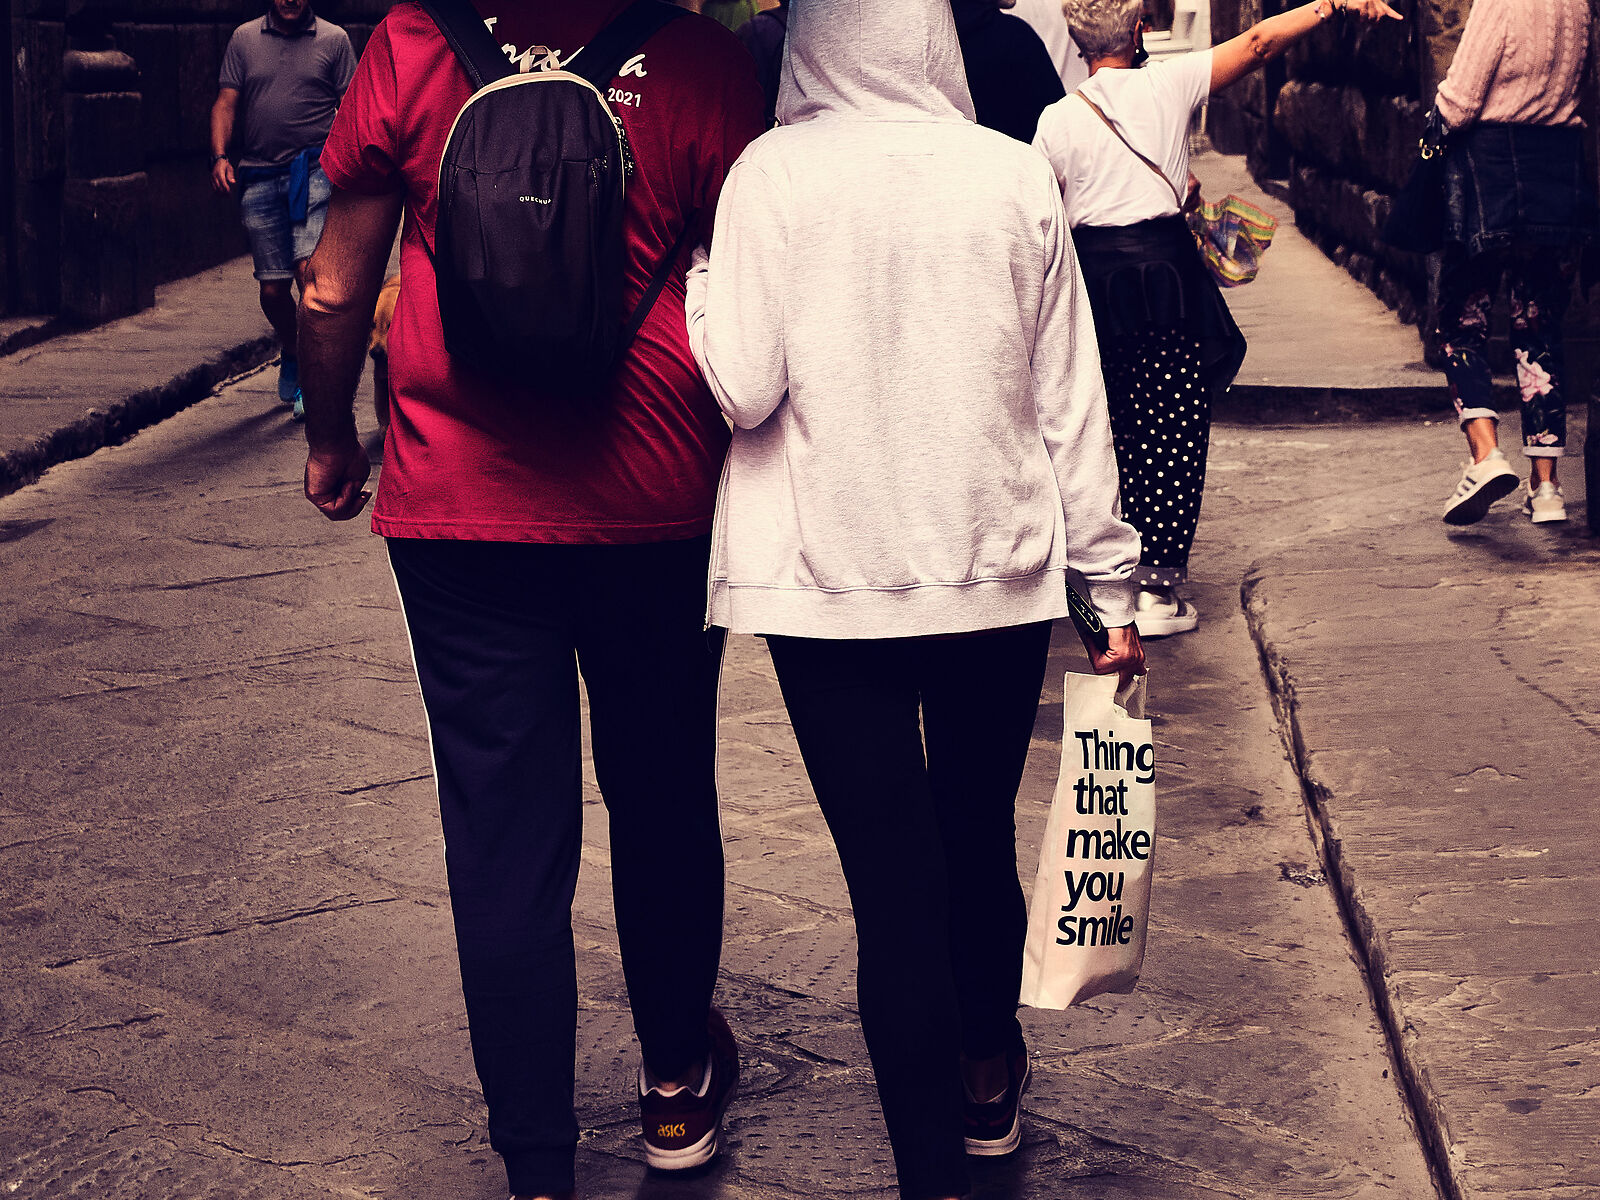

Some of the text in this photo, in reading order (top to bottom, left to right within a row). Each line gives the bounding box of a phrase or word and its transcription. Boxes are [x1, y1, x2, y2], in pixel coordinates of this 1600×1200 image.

[607, 87, 642, 108] 2021
[1073, 773, 1129, 815] that
[1066, 818, 1151, 860] make
[1061, 870, 1124, 912] you
[1056, 904, 1134, 947] smile
